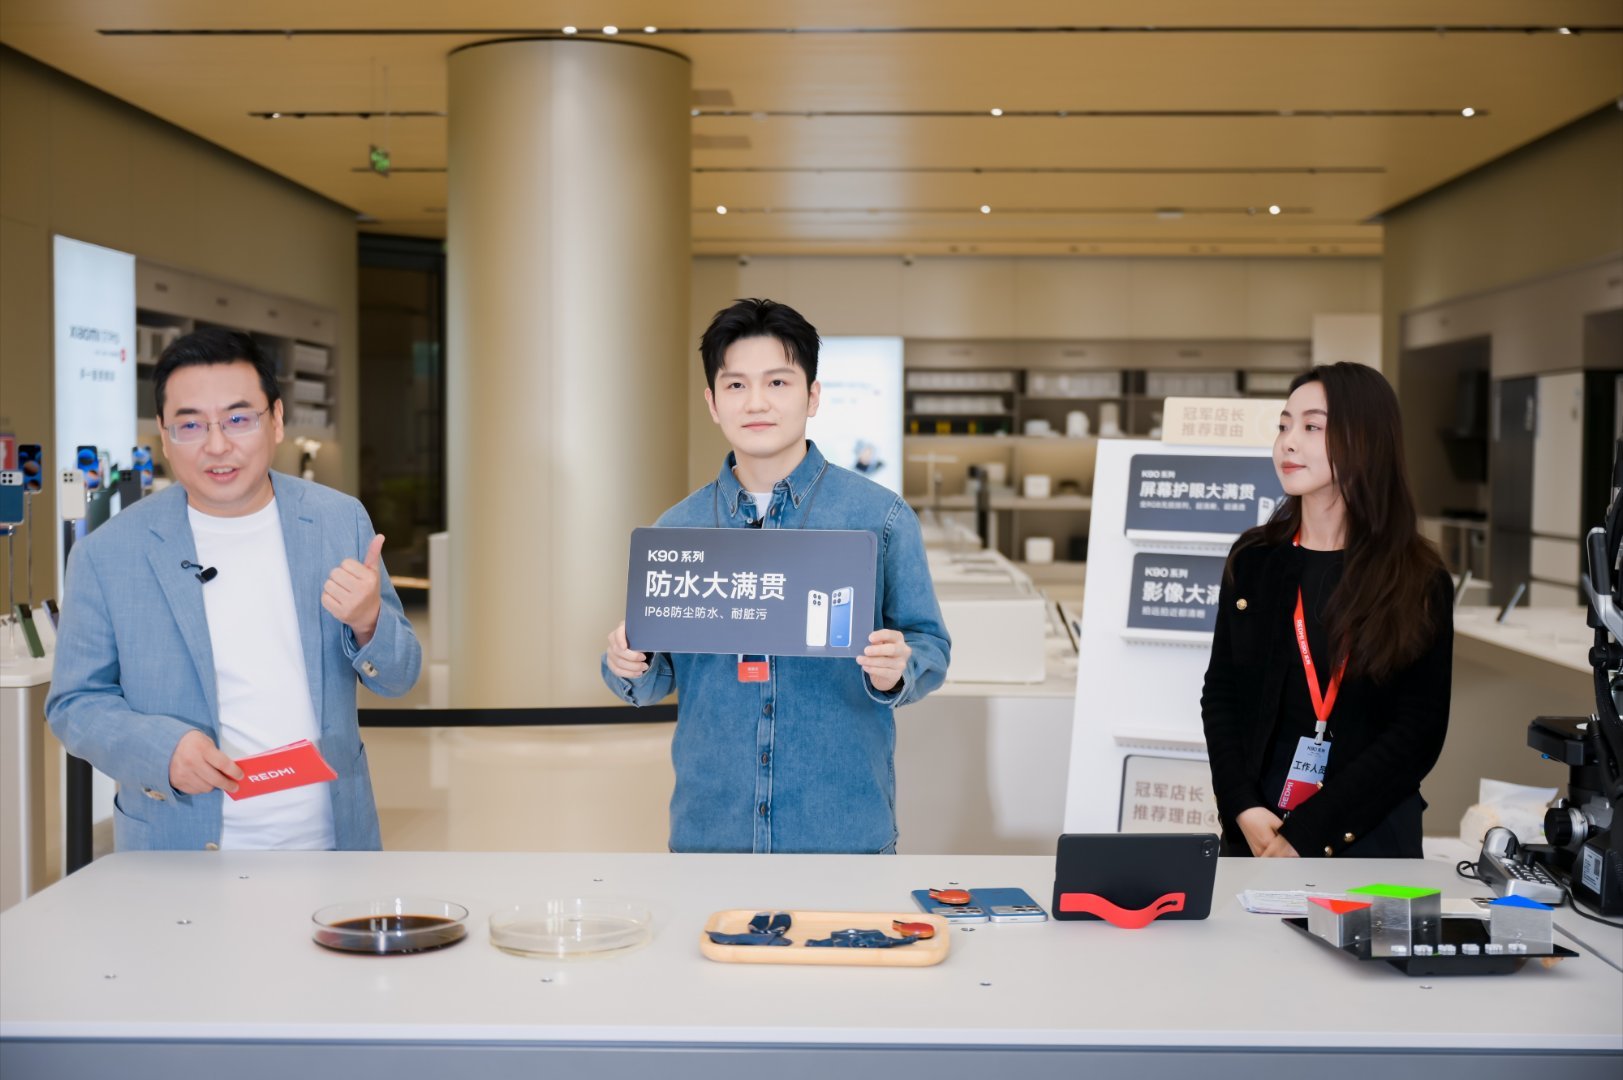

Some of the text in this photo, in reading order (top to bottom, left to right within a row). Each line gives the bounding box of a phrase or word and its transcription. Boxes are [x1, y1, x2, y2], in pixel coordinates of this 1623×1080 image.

[1183, 406, 1245, 421] 冠军店长
[1182, 422, 1244, 437] 推荐理由
[1139, 481, 1256, 500] 屏幕护眼大满贯
[648, 550, 705, 563] K90 系列
[1145, 567, 1169, 578] K90
[645, 570, 787, 600] 防水大满贯
[645, 606, 768, 620] IP68防尘防水、耐脏污
[247, 766, 296, 783] REDMI
[1293, 760, 1327, 775] 工作人员
[1135, 781, 1204, 802] 冠军店长
[1280, 781, 1294, 807] REDMI
